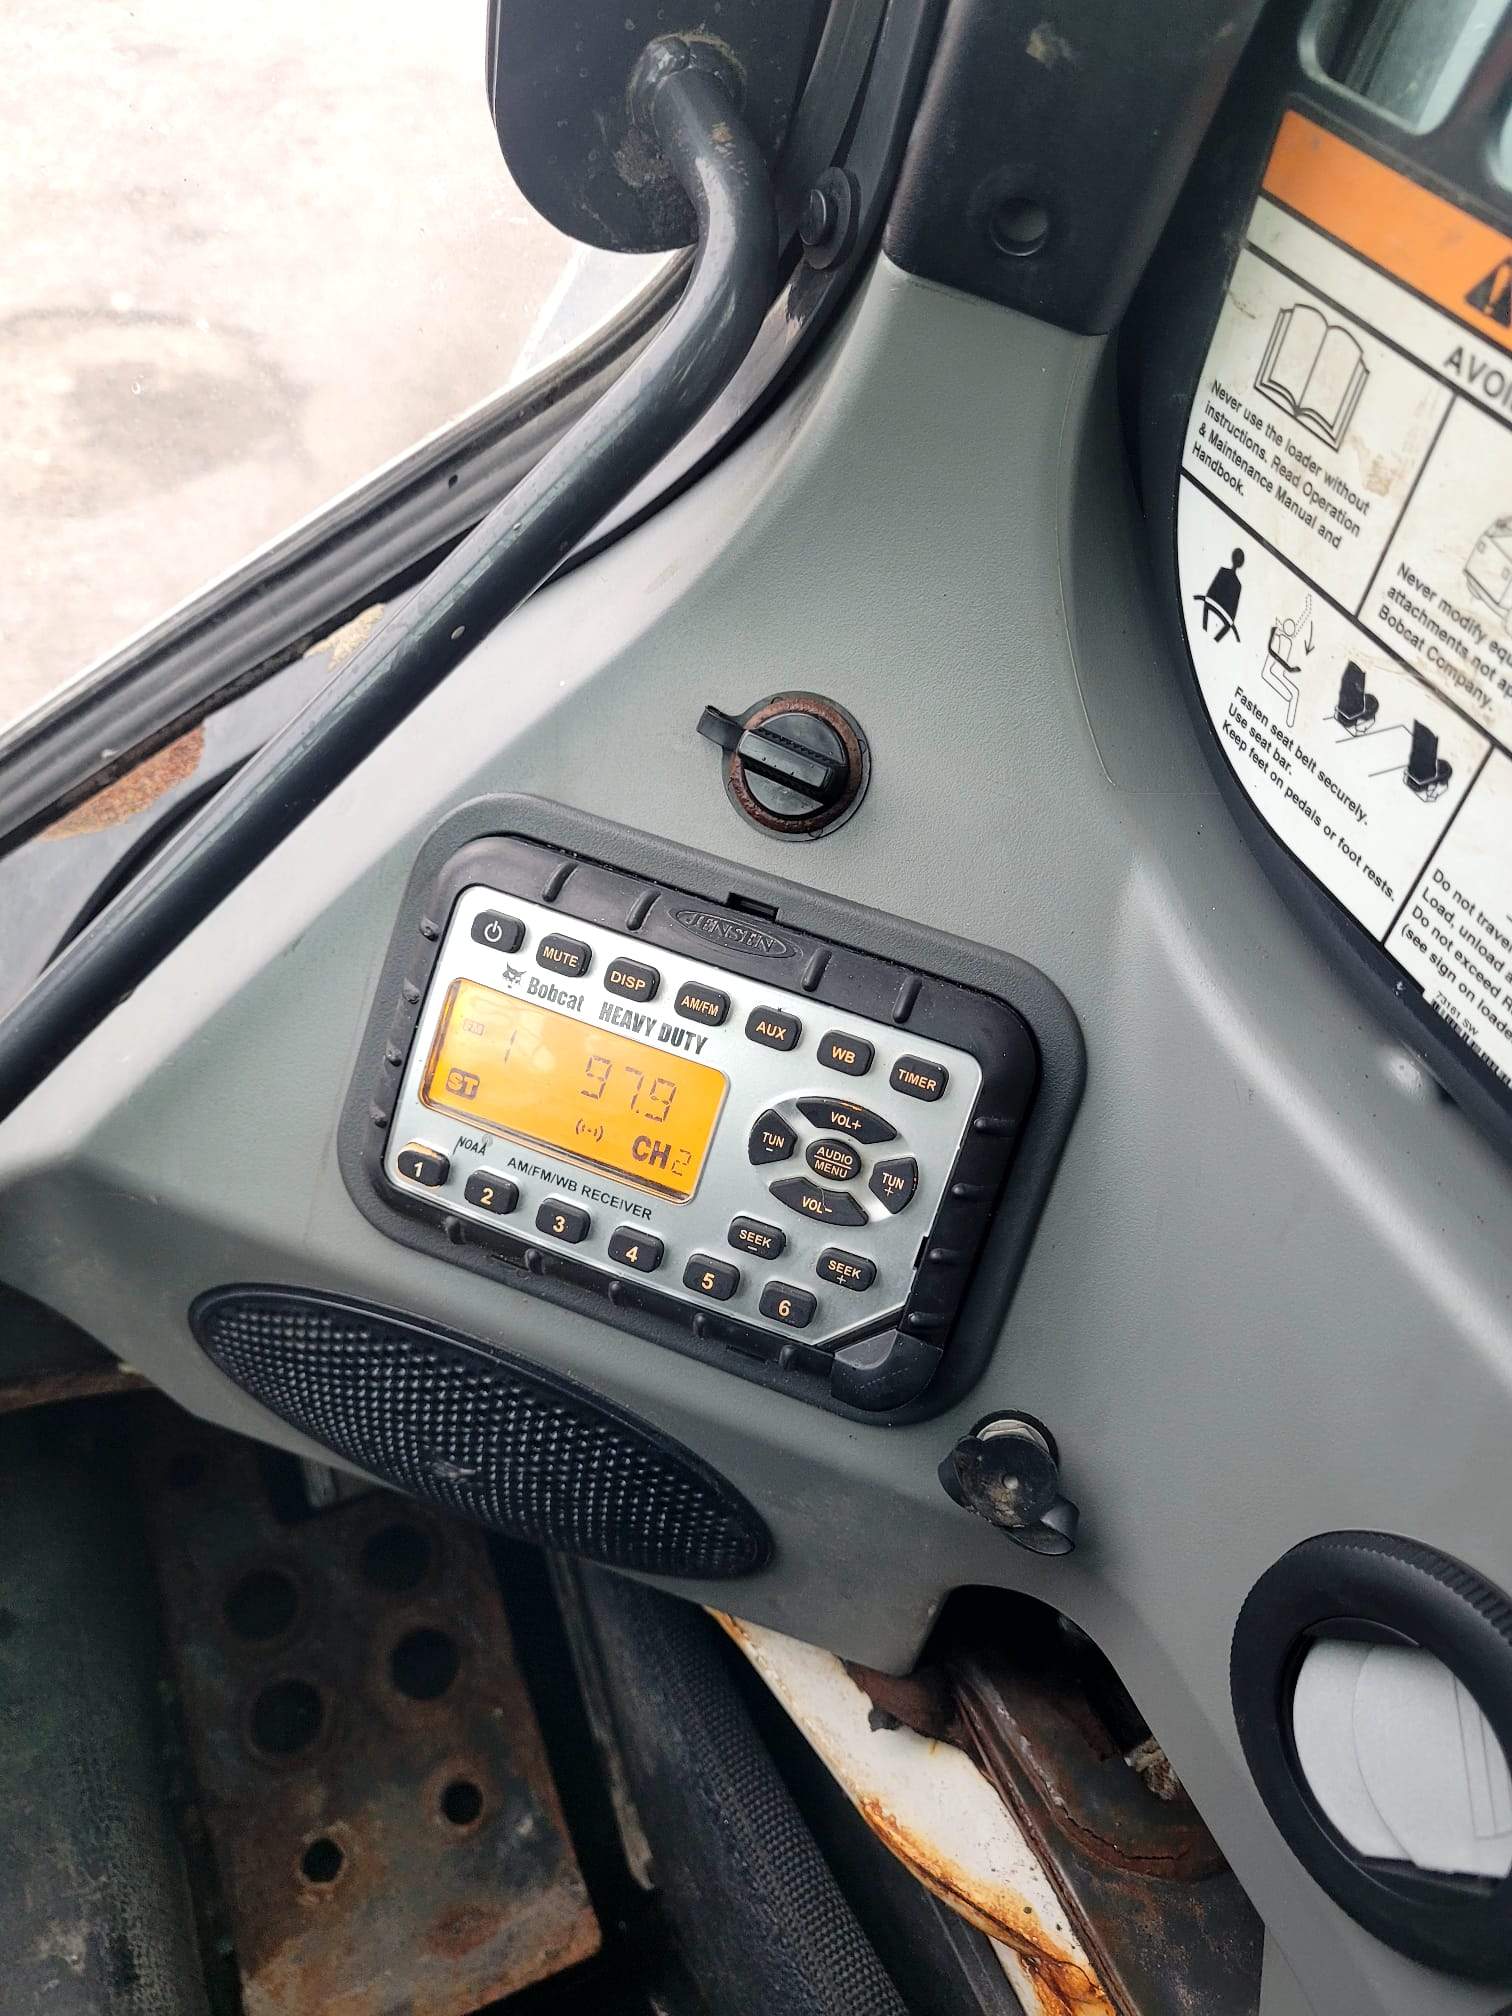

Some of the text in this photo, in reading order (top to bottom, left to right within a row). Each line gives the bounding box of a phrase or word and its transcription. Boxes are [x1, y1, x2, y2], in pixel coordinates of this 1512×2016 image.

[1443, 346, 1512, 412] AVOI
[1211, 380, 1371, 517] Never use the loader without
[1193, 441, 1245, 496] Handbook.
[1204, 400, 1361, 538] instructions. Read Operation
[1199, 422, 1342, 550] & Maintenance Manual and
[1397, 562, 1437, 602] Never
[1438, 598, 1487, 645] modify
[1387, 587, 1469, 659] attachments
[1471, 655, 1496, 681] not
[1378, 604, 1493, 711] Bobcat Company.
[1228, 703, 1293, 775] Use seat bar.
[1234, 686, 1368, 825] Fasten seat belt securely.
[1222, 719, 1395, 901] Keep feet on pedals or foot rests.
[1432, 868, 1451, 892] Do
[1453, 890, 1476, 916] not
[685, 913, 775, 952] JENSEN
[1422, 887, 1455, 928] Load,
[1459, 925, 1505, 972] unload
[543, 946, 579, 968] MUTE
[1412, 905, 1429, 928] Do
[1431, 927, 1454, 952] not
[1454, 950, 1501, 998] exceed
[610, 970, 646, 991] DISP
[1401, 923, 1512, 1044] (see sign on loade
[527, 976, 708, 1055] Bobcat HEAVY DUTY
[681, 995, 719, 1017] AM/FM
[756, 1021, 787, 1041] AUX
[1463, 1018, 1479, 1035] SW
[832, 1046, 856, 1064] WB
[447, 1071, 479, 1096] ST
[898, 1068, 937, 1091] TIMER
[452, 1135, 487, 1156] NOAA
[762, 1131, 785, 1148] TUN
[632, 1135, 671, 1169] CH
[816, 1146, 853, 1165] AUDIO
[413, 1161, 424, 1178] 1
[814, 1160, 848, 1178] MENU
[882, 1172, 905, 1190] TUN
[480, 1187, 494, 1206] 2
[507, 1157, 651, 1220] AM/FM/WB RECEIVER
[553, 1215, 565, 1233] 3
[739, 1229, 772, 1248] SEEK
[625, 1245, 638, 1263] 4
[701, 1272, 715, 1290] 5
[828, 1259, 862, 1280] SEEK
[778, 1299, 792, 1317] 6
